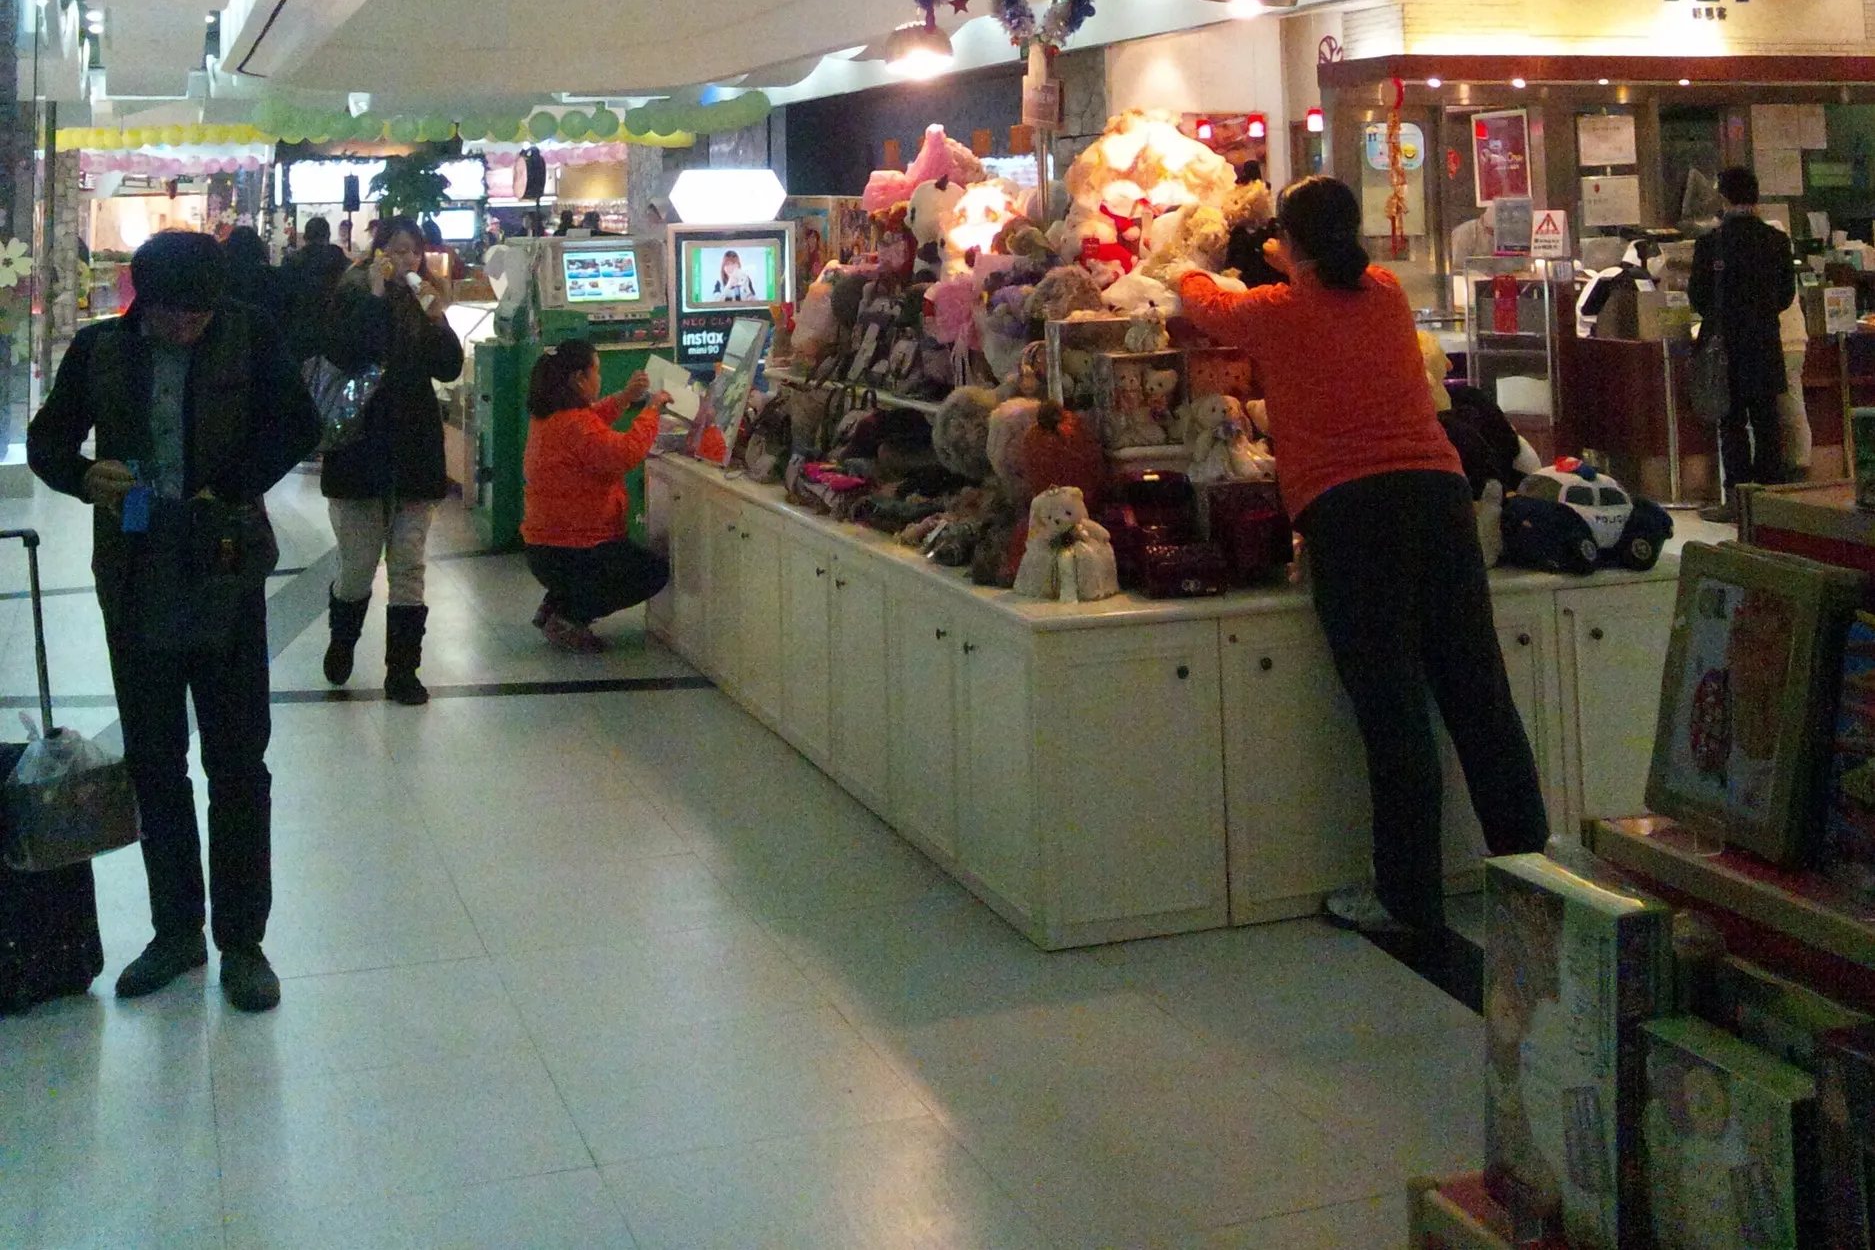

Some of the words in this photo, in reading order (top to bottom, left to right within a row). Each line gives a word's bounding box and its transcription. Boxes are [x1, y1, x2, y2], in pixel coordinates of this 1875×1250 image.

[682, 317, 706, 326] NEO
[683, 330, 724, 346] instax
[688, 346, 707, 355] mini
[708, 345, 720, 354] 90
